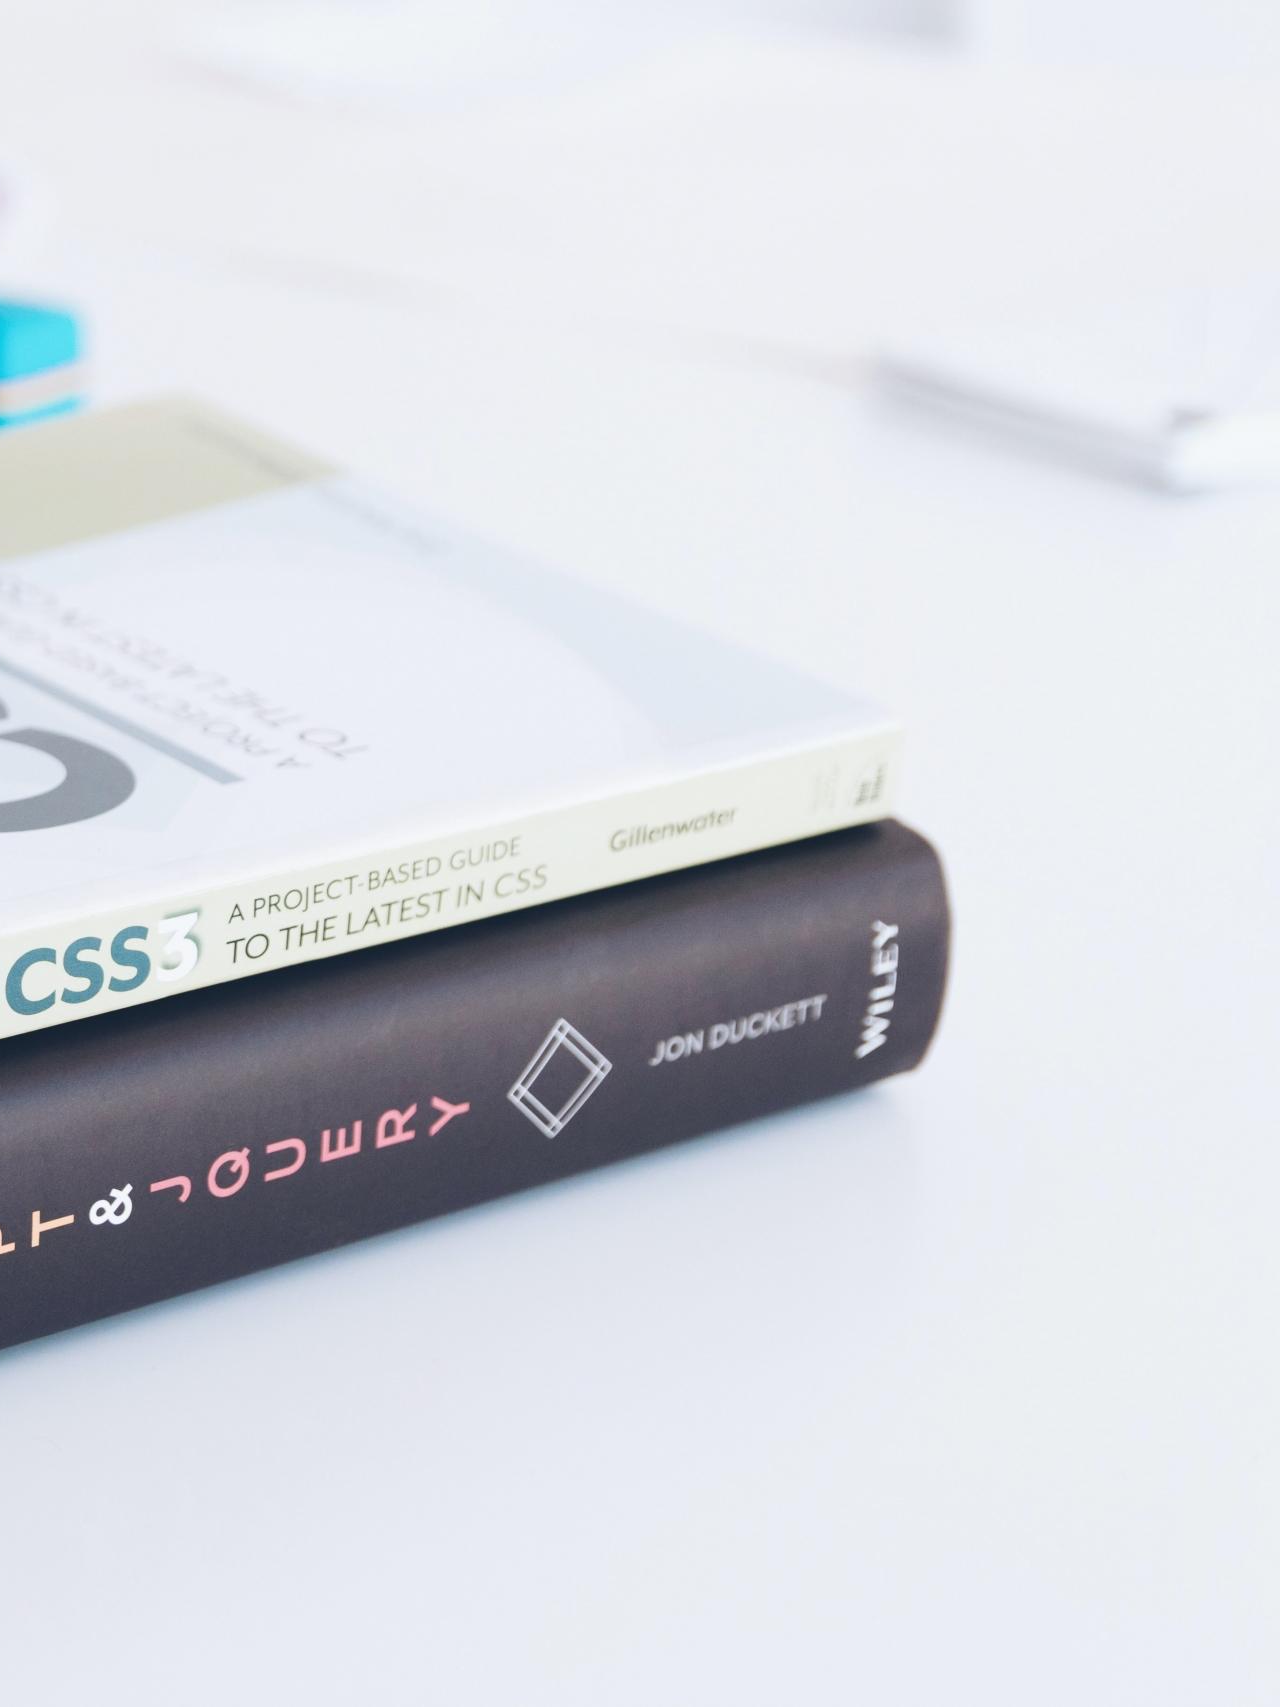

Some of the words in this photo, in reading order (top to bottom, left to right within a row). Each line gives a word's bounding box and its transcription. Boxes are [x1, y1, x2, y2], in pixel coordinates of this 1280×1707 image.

[228, 903, 245, 924] A
[253, 857, 442, 918] PROJECT-BASED
[449, 836, 523, 871] GUIDE
[609, 808, 738, 852] Gillenwater
[4, 908, 202, 1017] CSS3
[226, 933, 270, 964] TO
[279, 915, 339, 951] THE
[345, 887, 451, 936] LATEST
[456, 881, 485, 909] IN
[494, 864, 548, 899] CSS
[648, 1029, 704, 1067] JON
[707, 994, 829, 1050] DUCKETT
[854, 919, 900, 1060] WILEY
[88, 1182, 134, 1226] &
[149, 1094, 472, 1204] JQUERY
